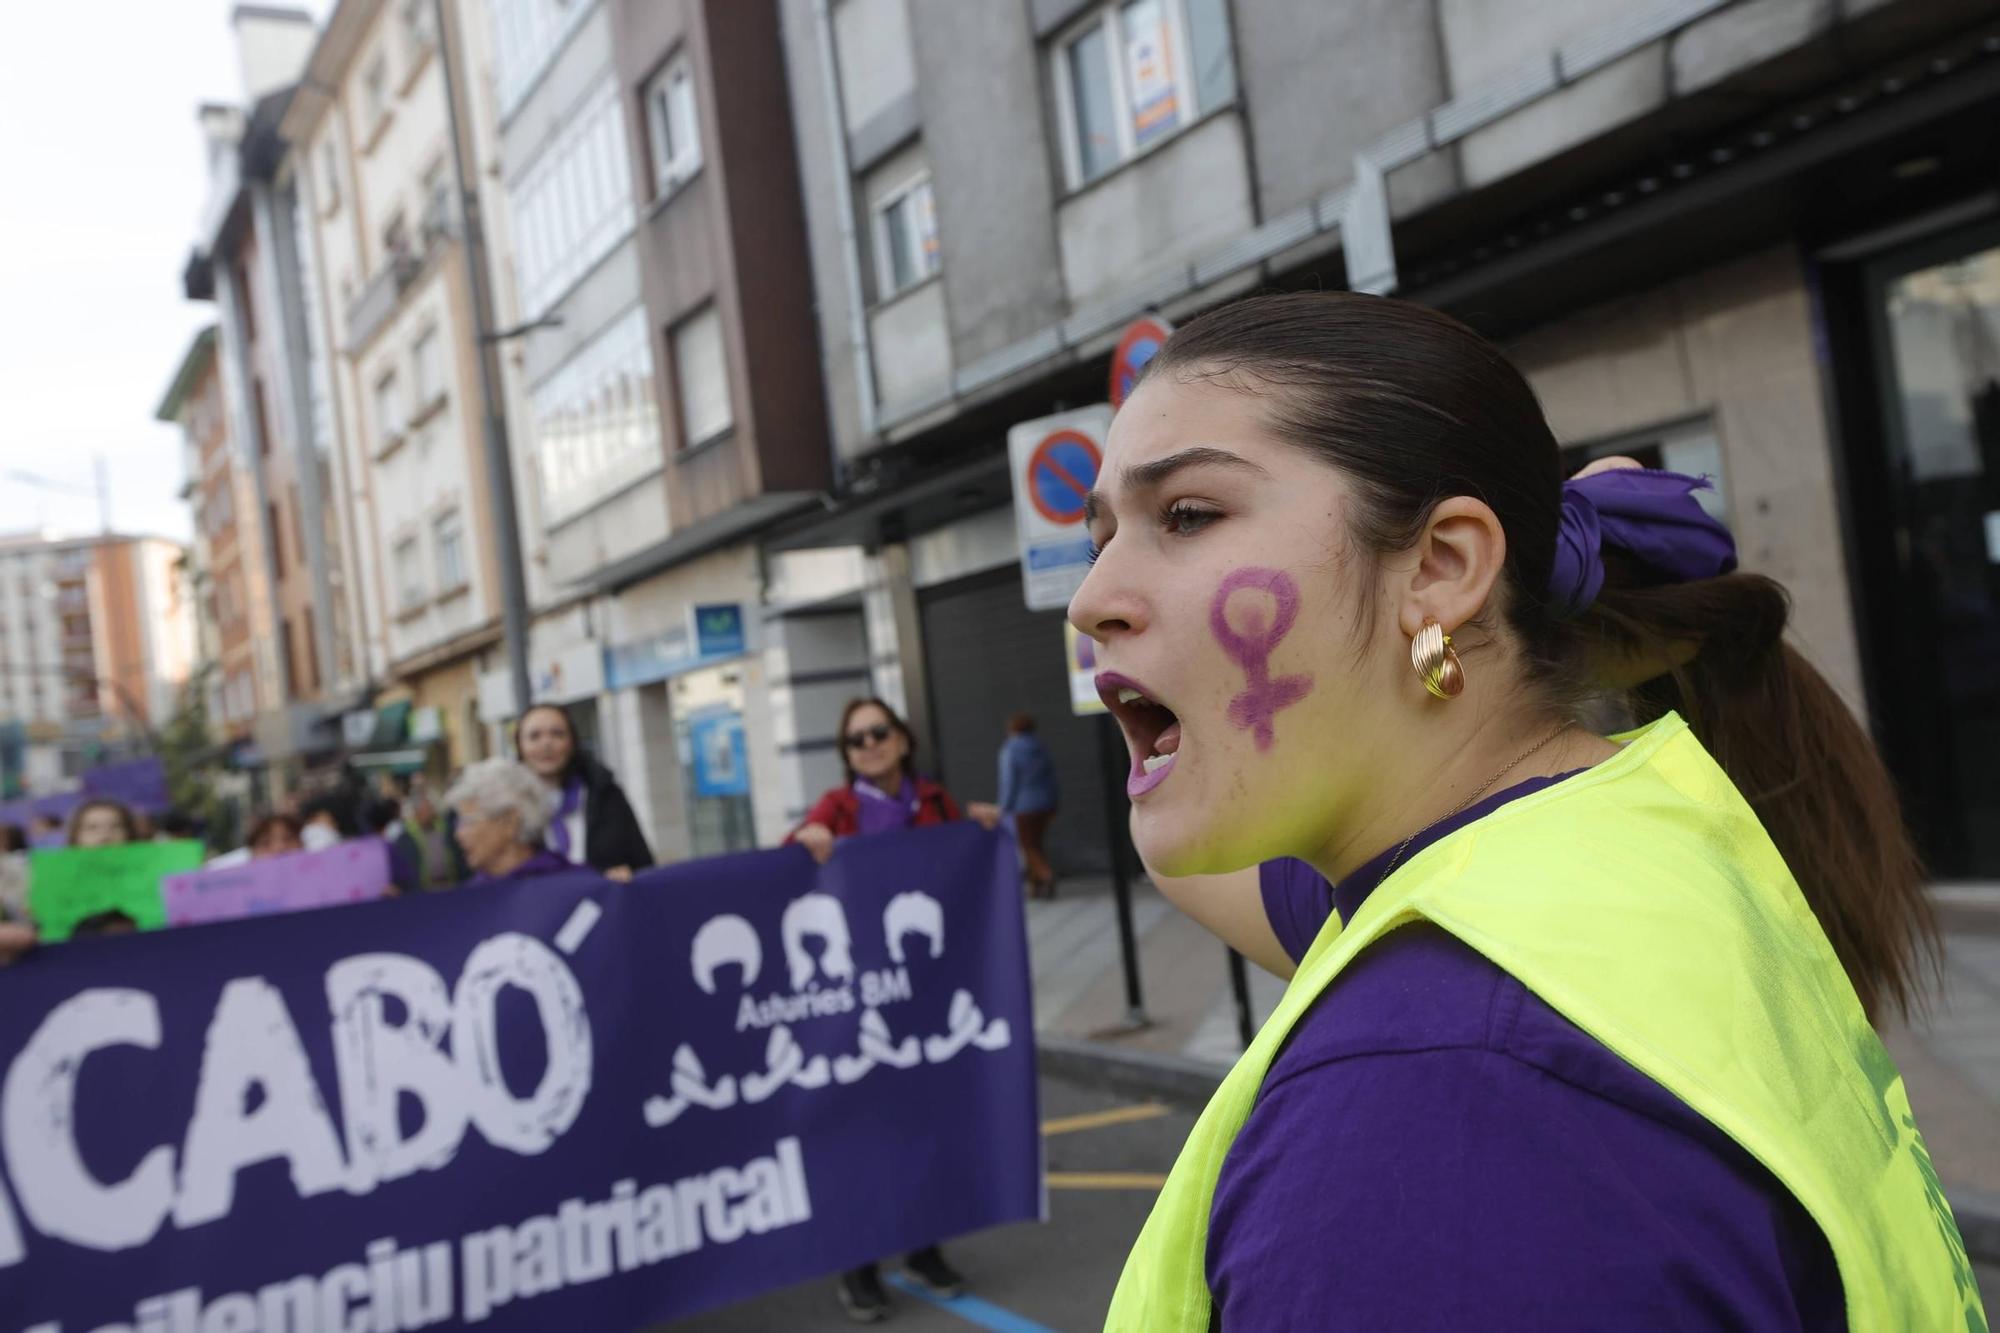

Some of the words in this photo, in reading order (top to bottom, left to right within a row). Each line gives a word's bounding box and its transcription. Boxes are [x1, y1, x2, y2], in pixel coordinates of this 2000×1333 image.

[0, 899, 602, 1268] CABÓ
[735, 981, 856, 1033] Asturies
[860, 966, 913, 1007] 8M
[85, 1235, 453, 1333] enciu
[461, 1136, 812, 1323] patriarcal
